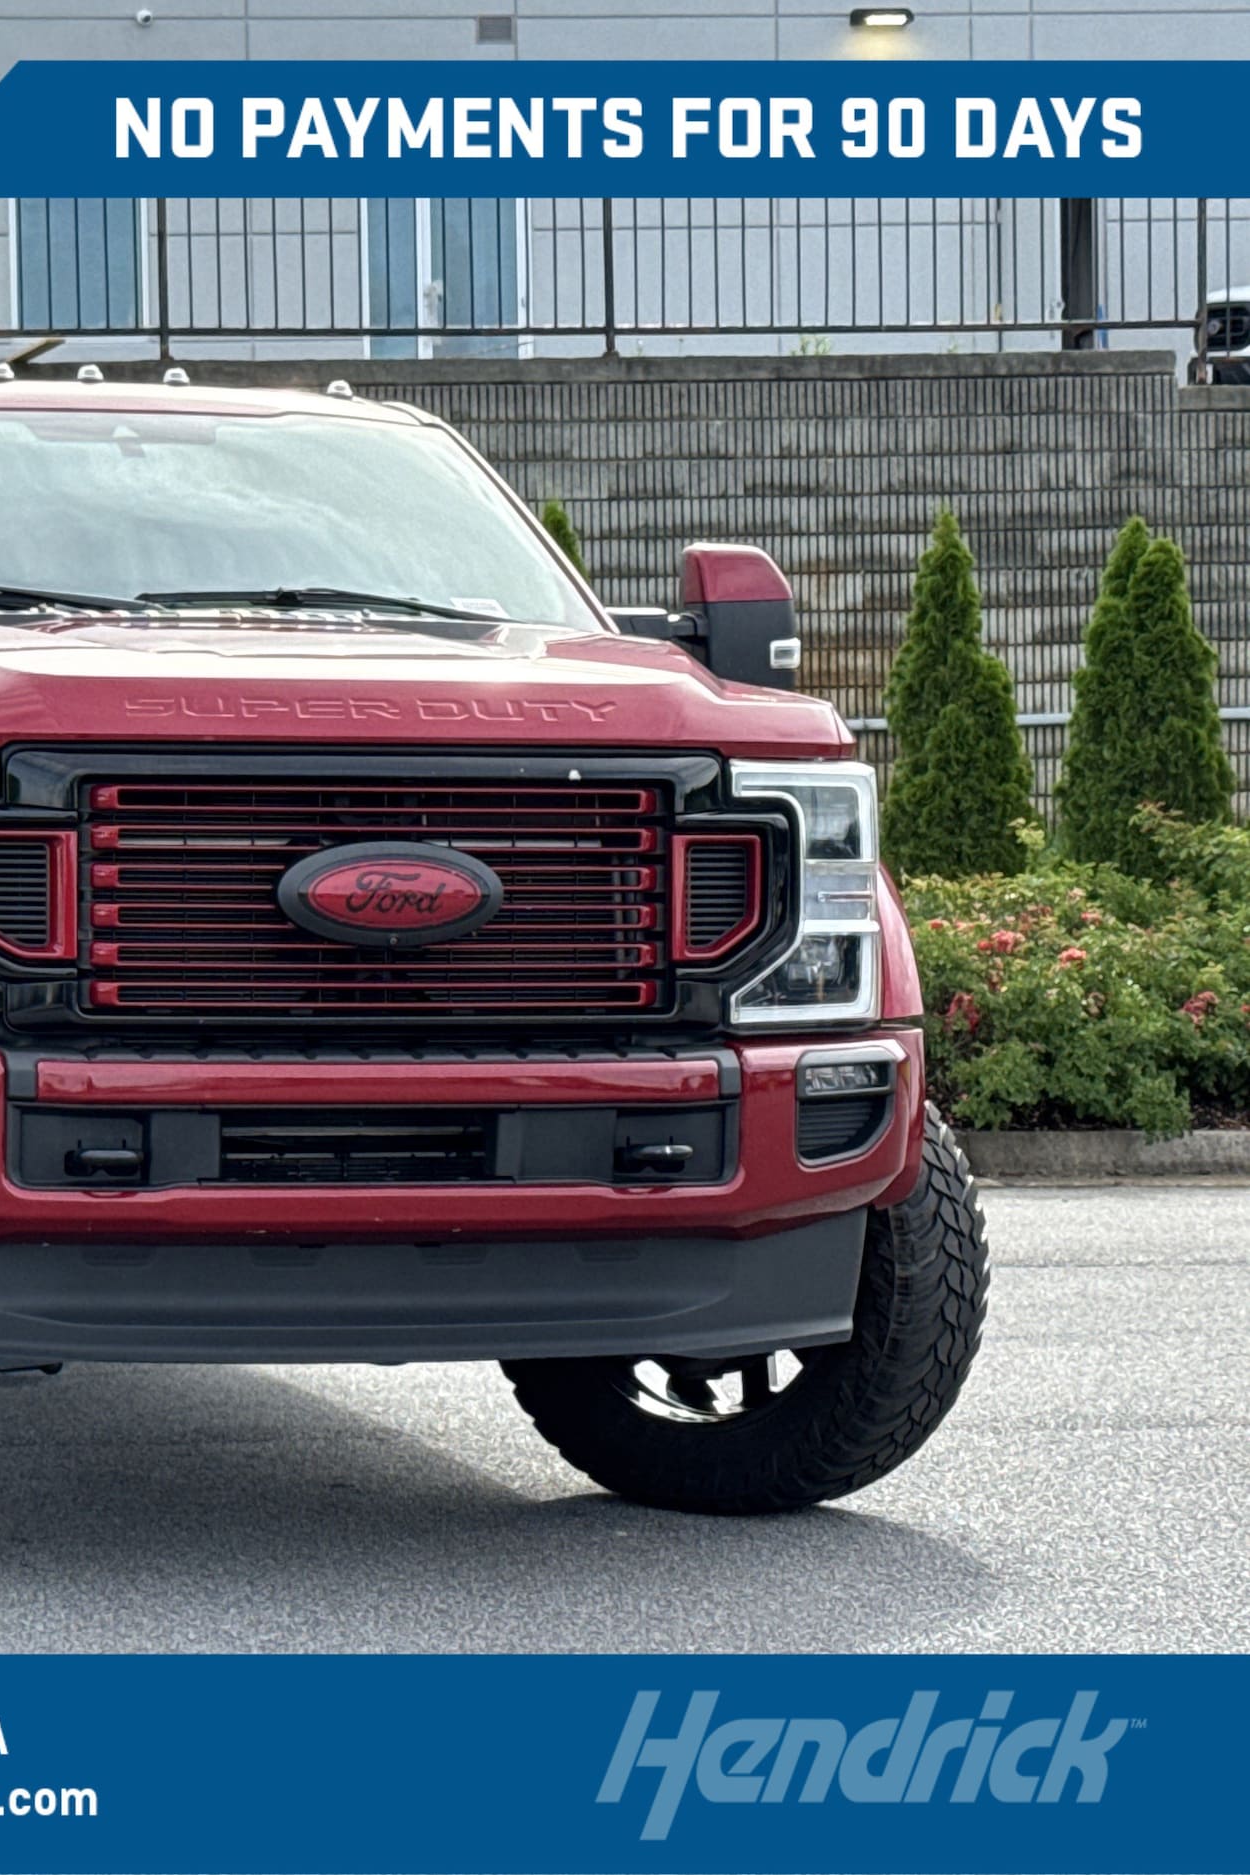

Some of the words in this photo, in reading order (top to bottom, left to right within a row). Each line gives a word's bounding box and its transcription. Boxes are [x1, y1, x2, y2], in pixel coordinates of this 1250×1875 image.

[125, 695, 401, 720] SUPER
[416, 698, 618, 723] DUTY
[345, 871, 445, 915] Ford
